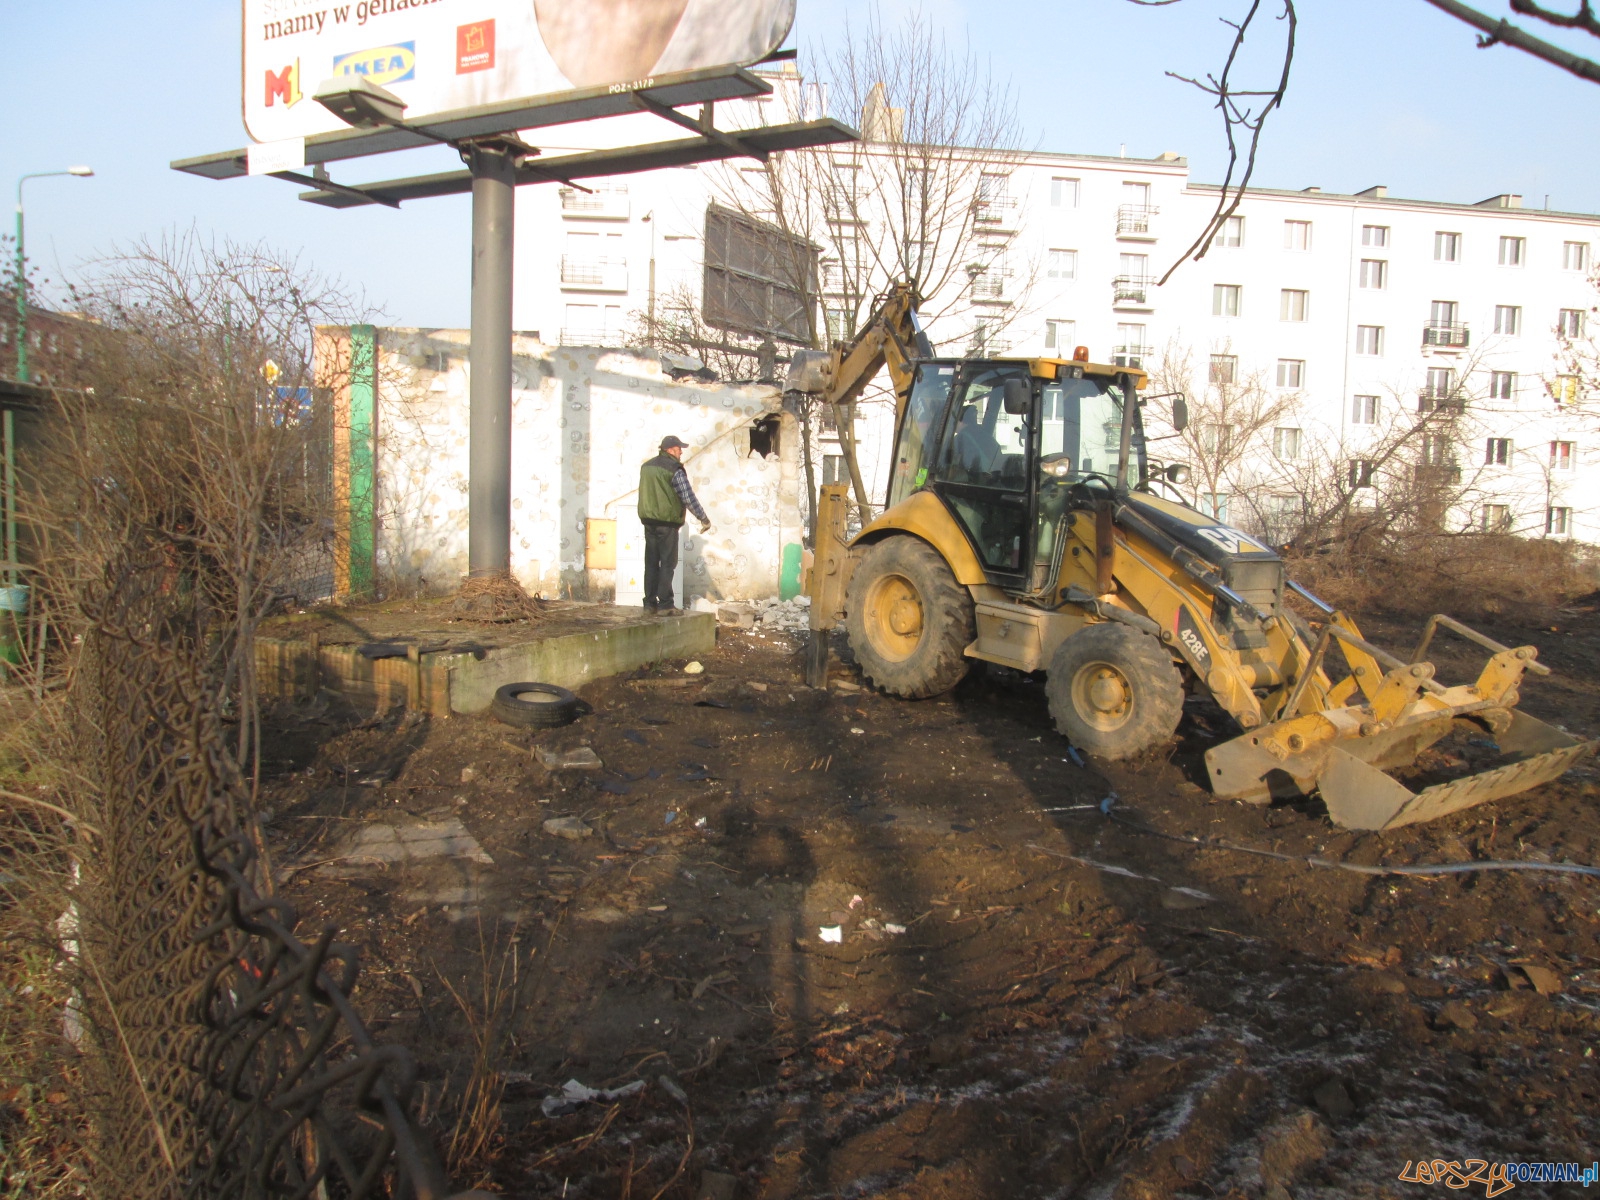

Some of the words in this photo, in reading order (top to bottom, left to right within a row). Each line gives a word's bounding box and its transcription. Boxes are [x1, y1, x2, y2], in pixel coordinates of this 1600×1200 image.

[264, 10, 327, 41] mamy
[333, 5, 351, 24] w
[343, 54, 405, 76] IKEA
[1197, 527, 1270, 554] CAT
[1180, 629, 1208, 661] 428E
